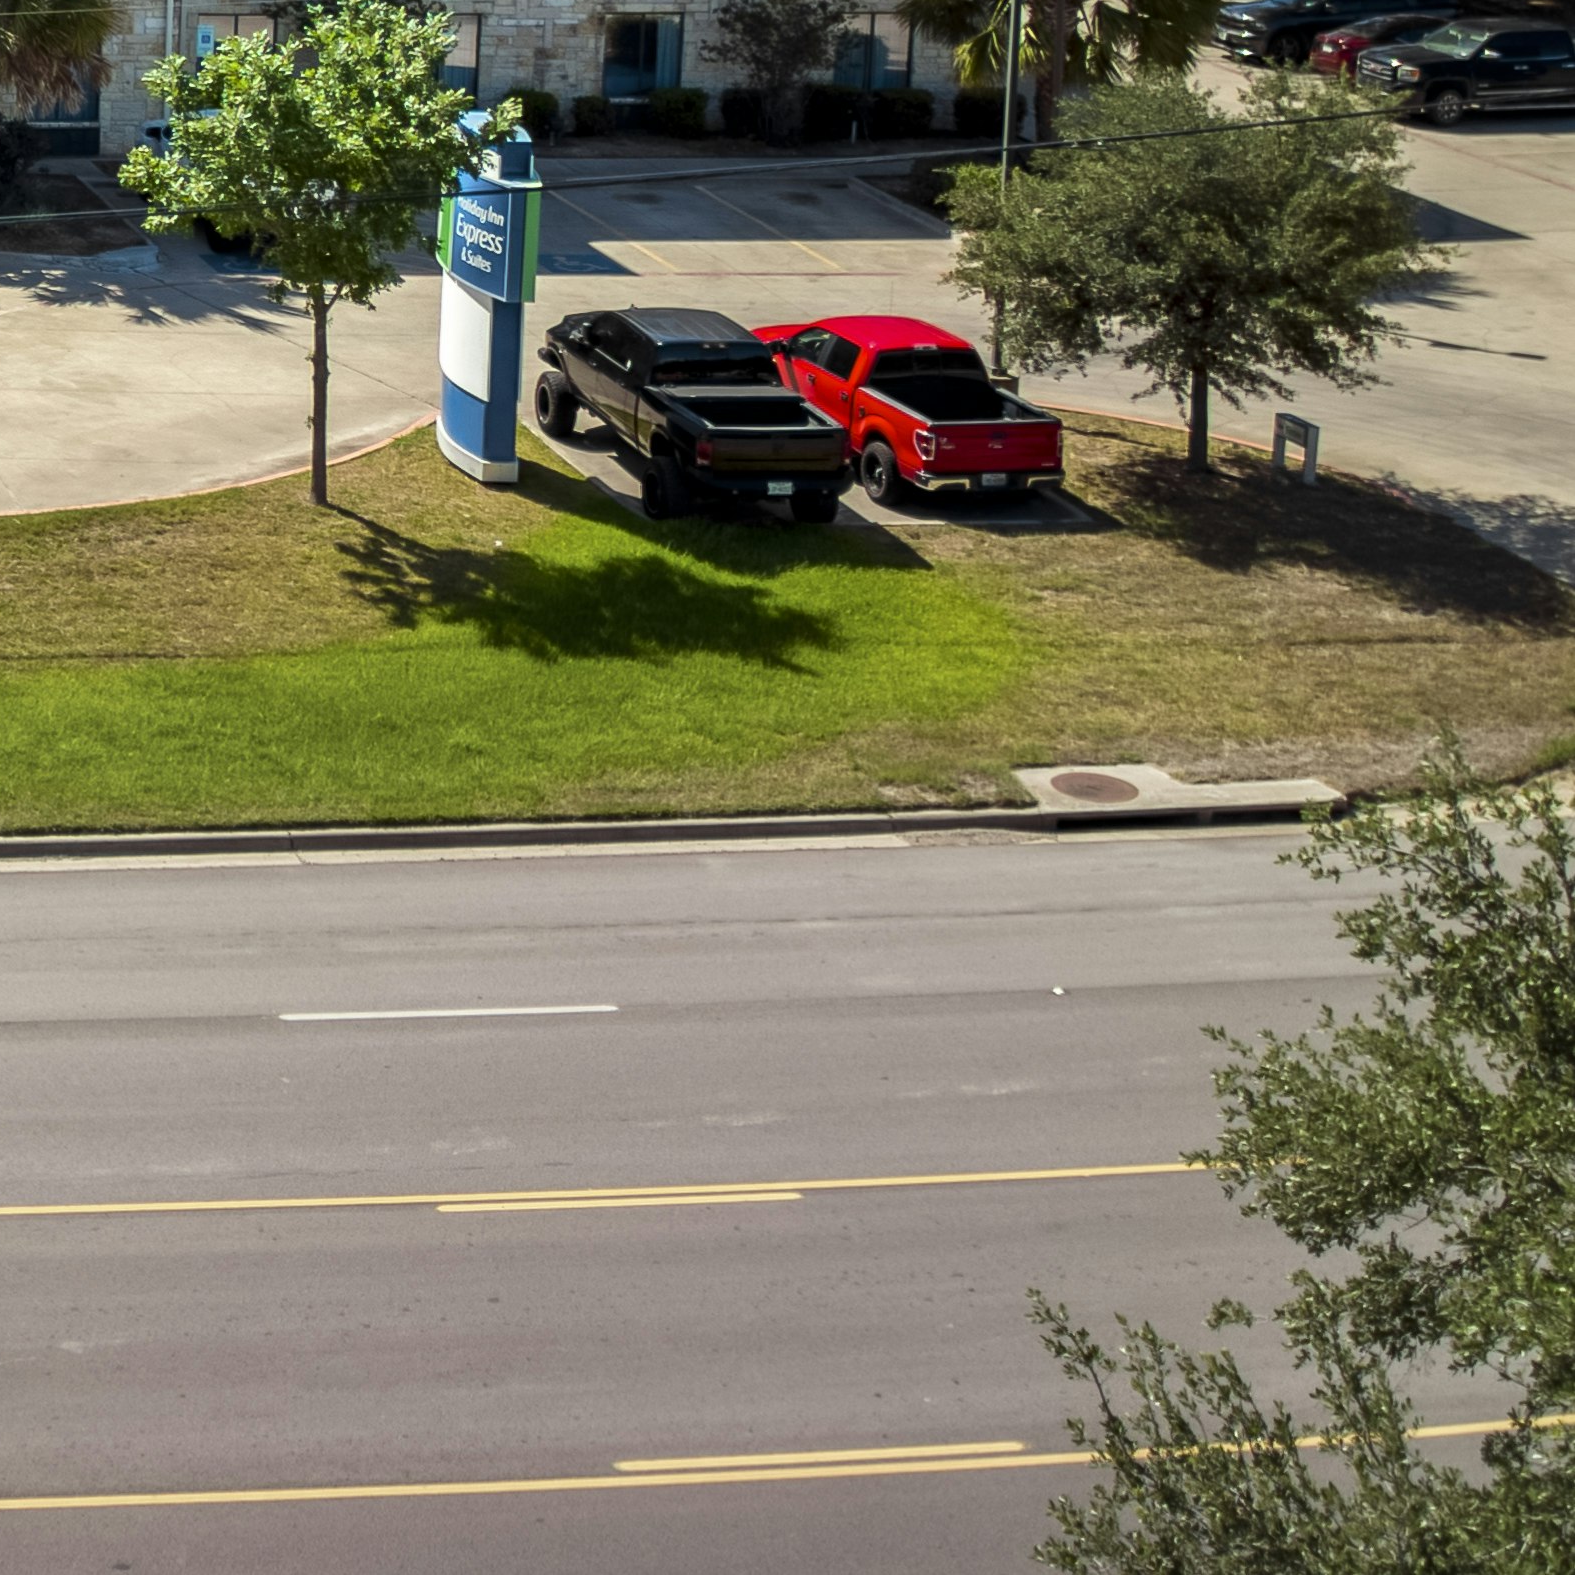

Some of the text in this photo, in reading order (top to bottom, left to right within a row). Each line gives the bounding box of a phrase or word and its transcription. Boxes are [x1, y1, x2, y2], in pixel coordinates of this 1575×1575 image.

[458, 196, 504, 226] Holiday Inn
[456, 212, 503, 254] Express
[467, 249, 492, 273] Suites
